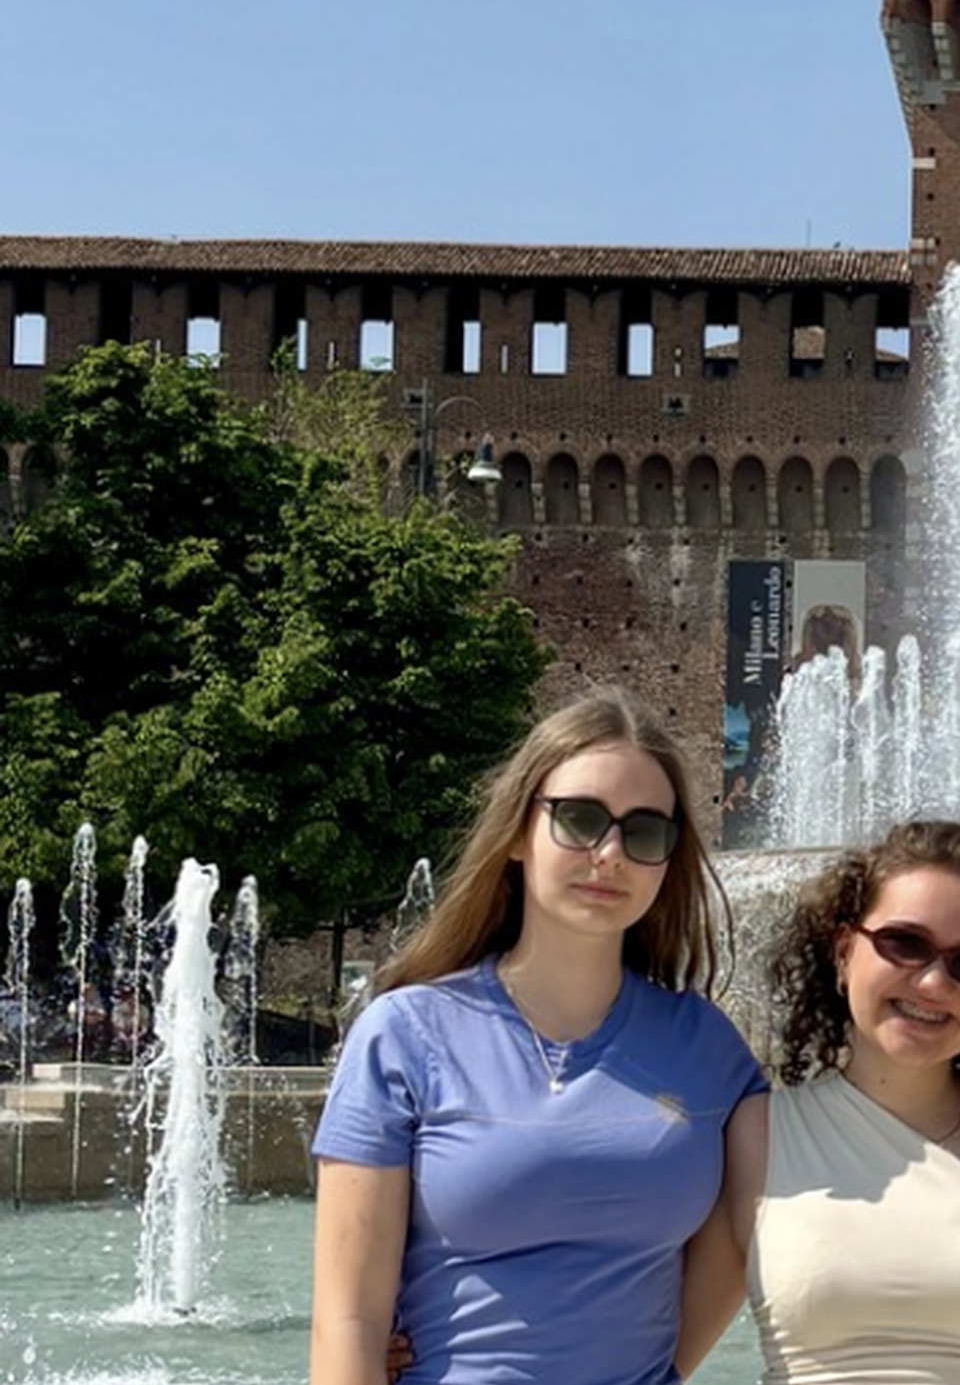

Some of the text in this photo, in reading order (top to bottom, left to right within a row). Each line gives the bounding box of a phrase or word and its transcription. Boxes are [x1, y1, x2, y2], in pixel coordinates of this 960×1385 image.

[743, 600, 762, 685] Milano e
[762, 566, 781, 660] Leonardo
